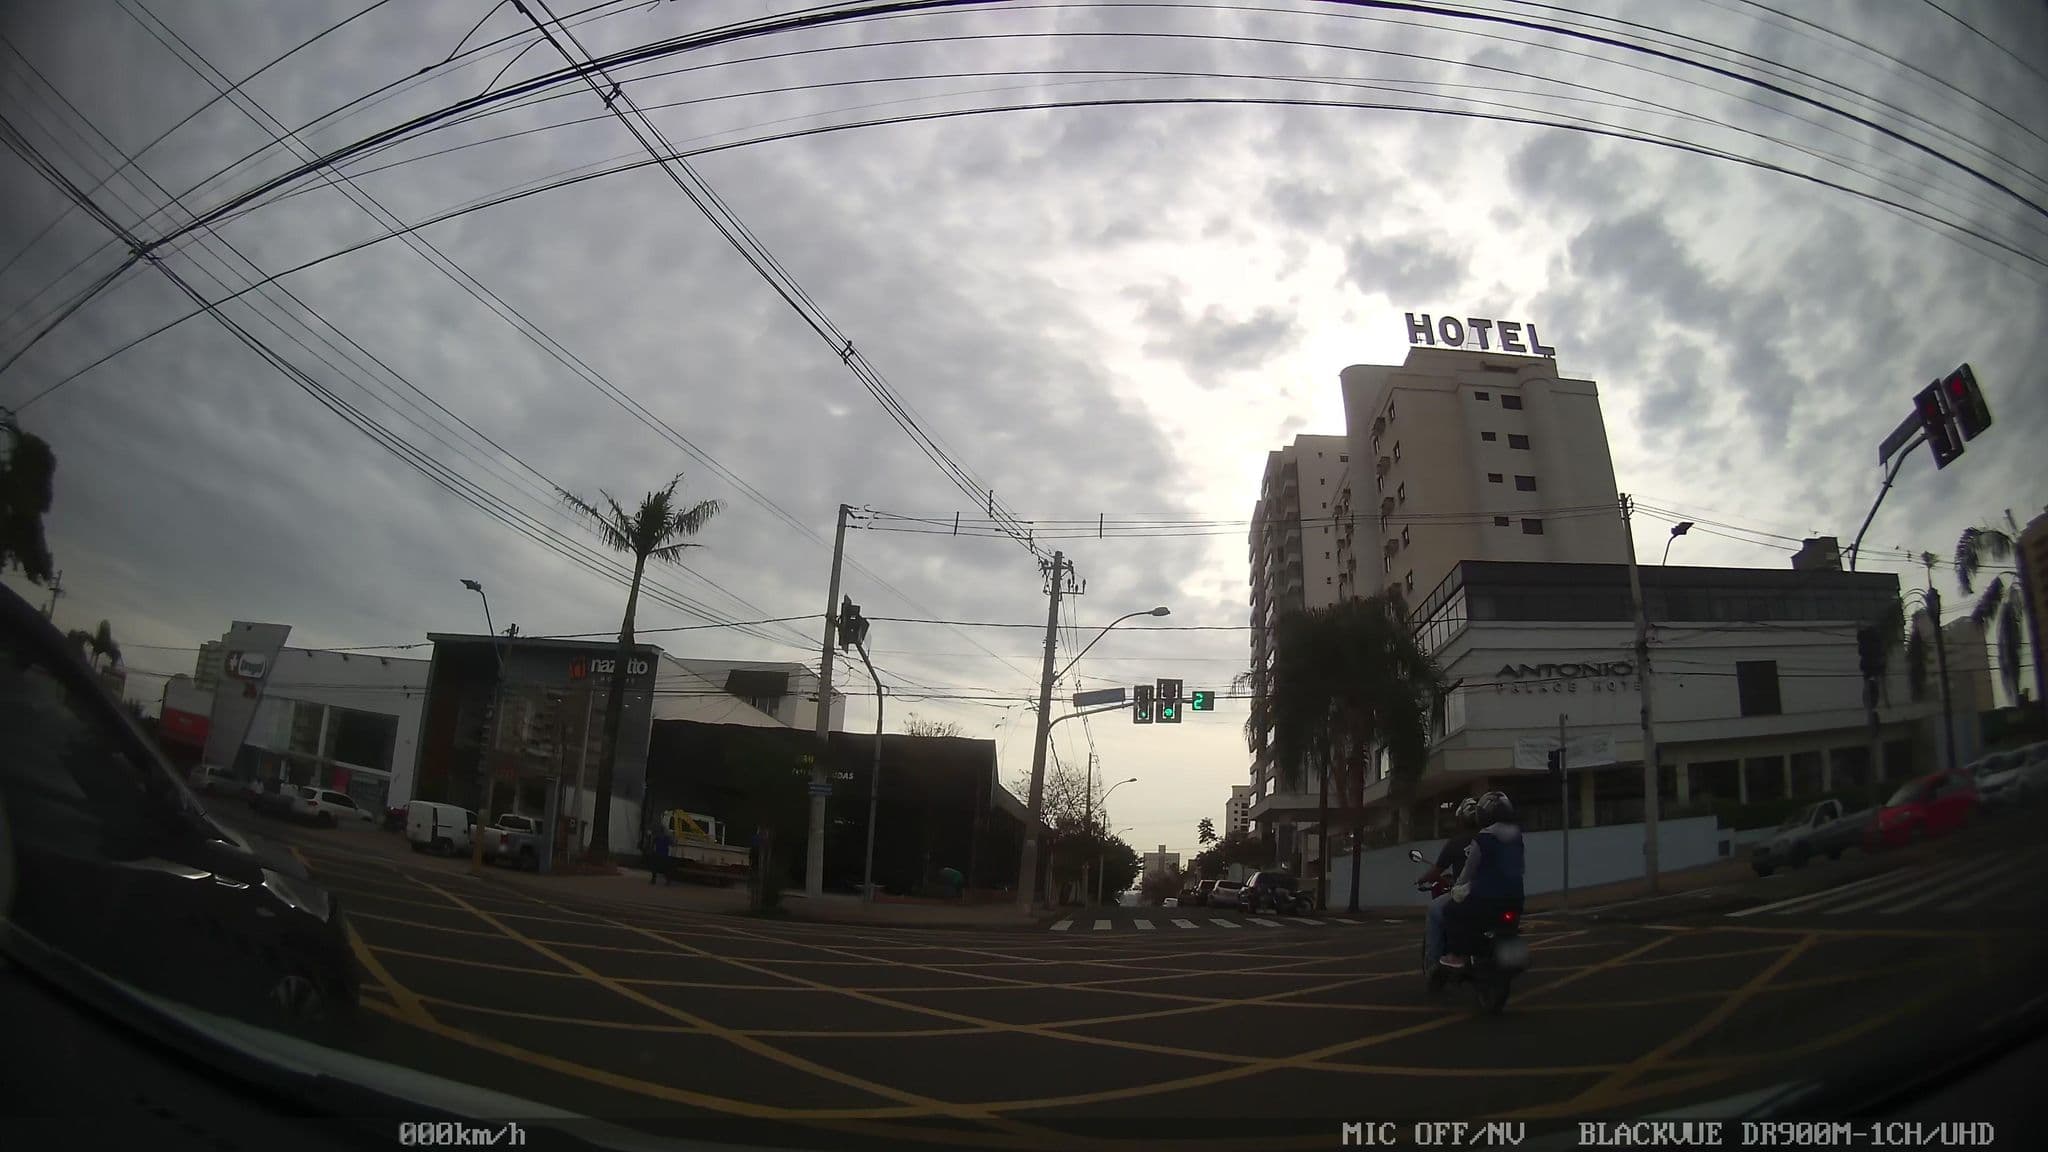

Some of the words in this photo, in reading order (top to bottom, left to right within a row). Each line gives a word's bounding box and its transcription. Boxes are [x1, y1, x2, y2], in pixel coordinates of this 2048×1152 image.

[1405, 312, 1556, 356] HOTEL
[590, 656, 649, 675] naztto
[1496, 663, 1633, 677] ANTONIO
[1594, 680, 1641, 692] HOTE
[1194, 692, 1203, 709] 2
